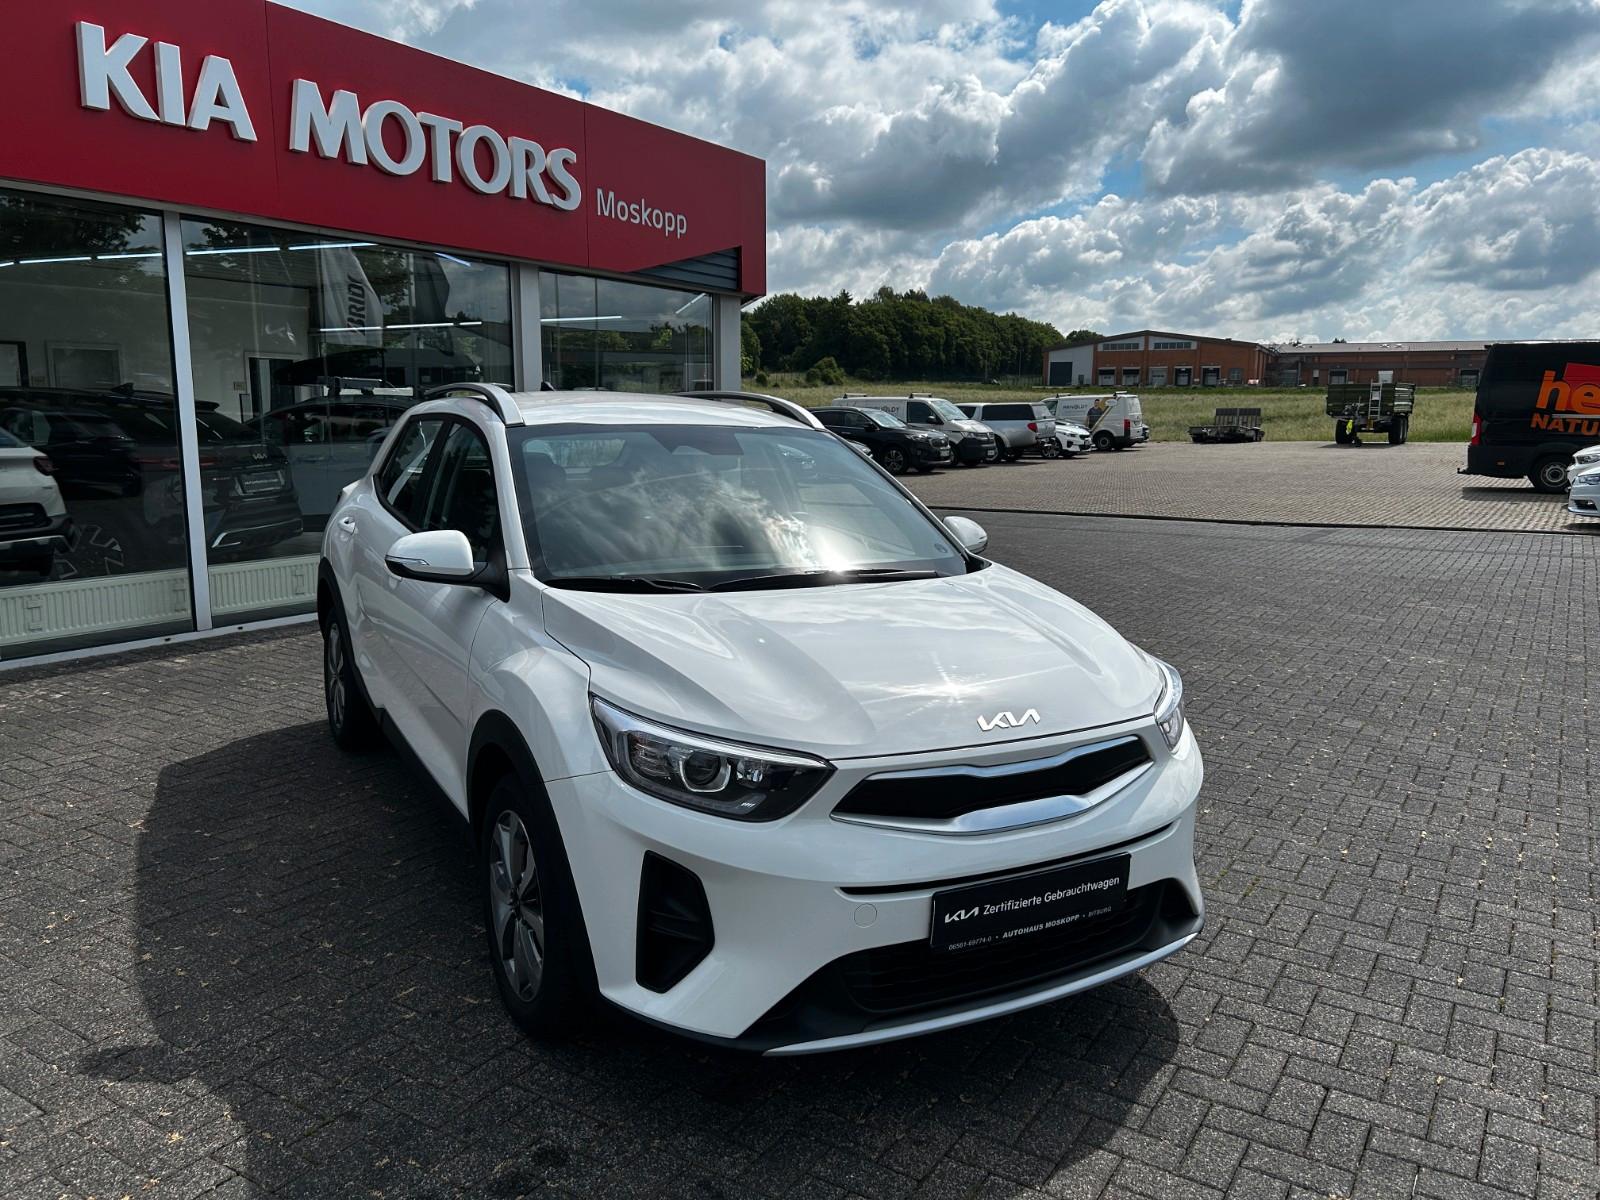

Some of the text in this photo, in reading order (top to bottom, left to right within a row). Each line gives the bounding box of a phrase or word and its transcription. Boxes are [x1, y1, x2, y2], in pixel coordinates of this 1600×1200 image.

[75, 20, 582, 211] KIA MOTORS
[597, 188, 687, 239] Moskopp
[1530, 412, 1600, 436] NATU
[983, 895, 1042, 915] Zertifizierte
[1044, 876, 1120, 903] Gebrauchtwagen
[1002, 923, 1044, 939] AUTOHAUS
[1045, 914, 1080, 928] MOSKOPP
